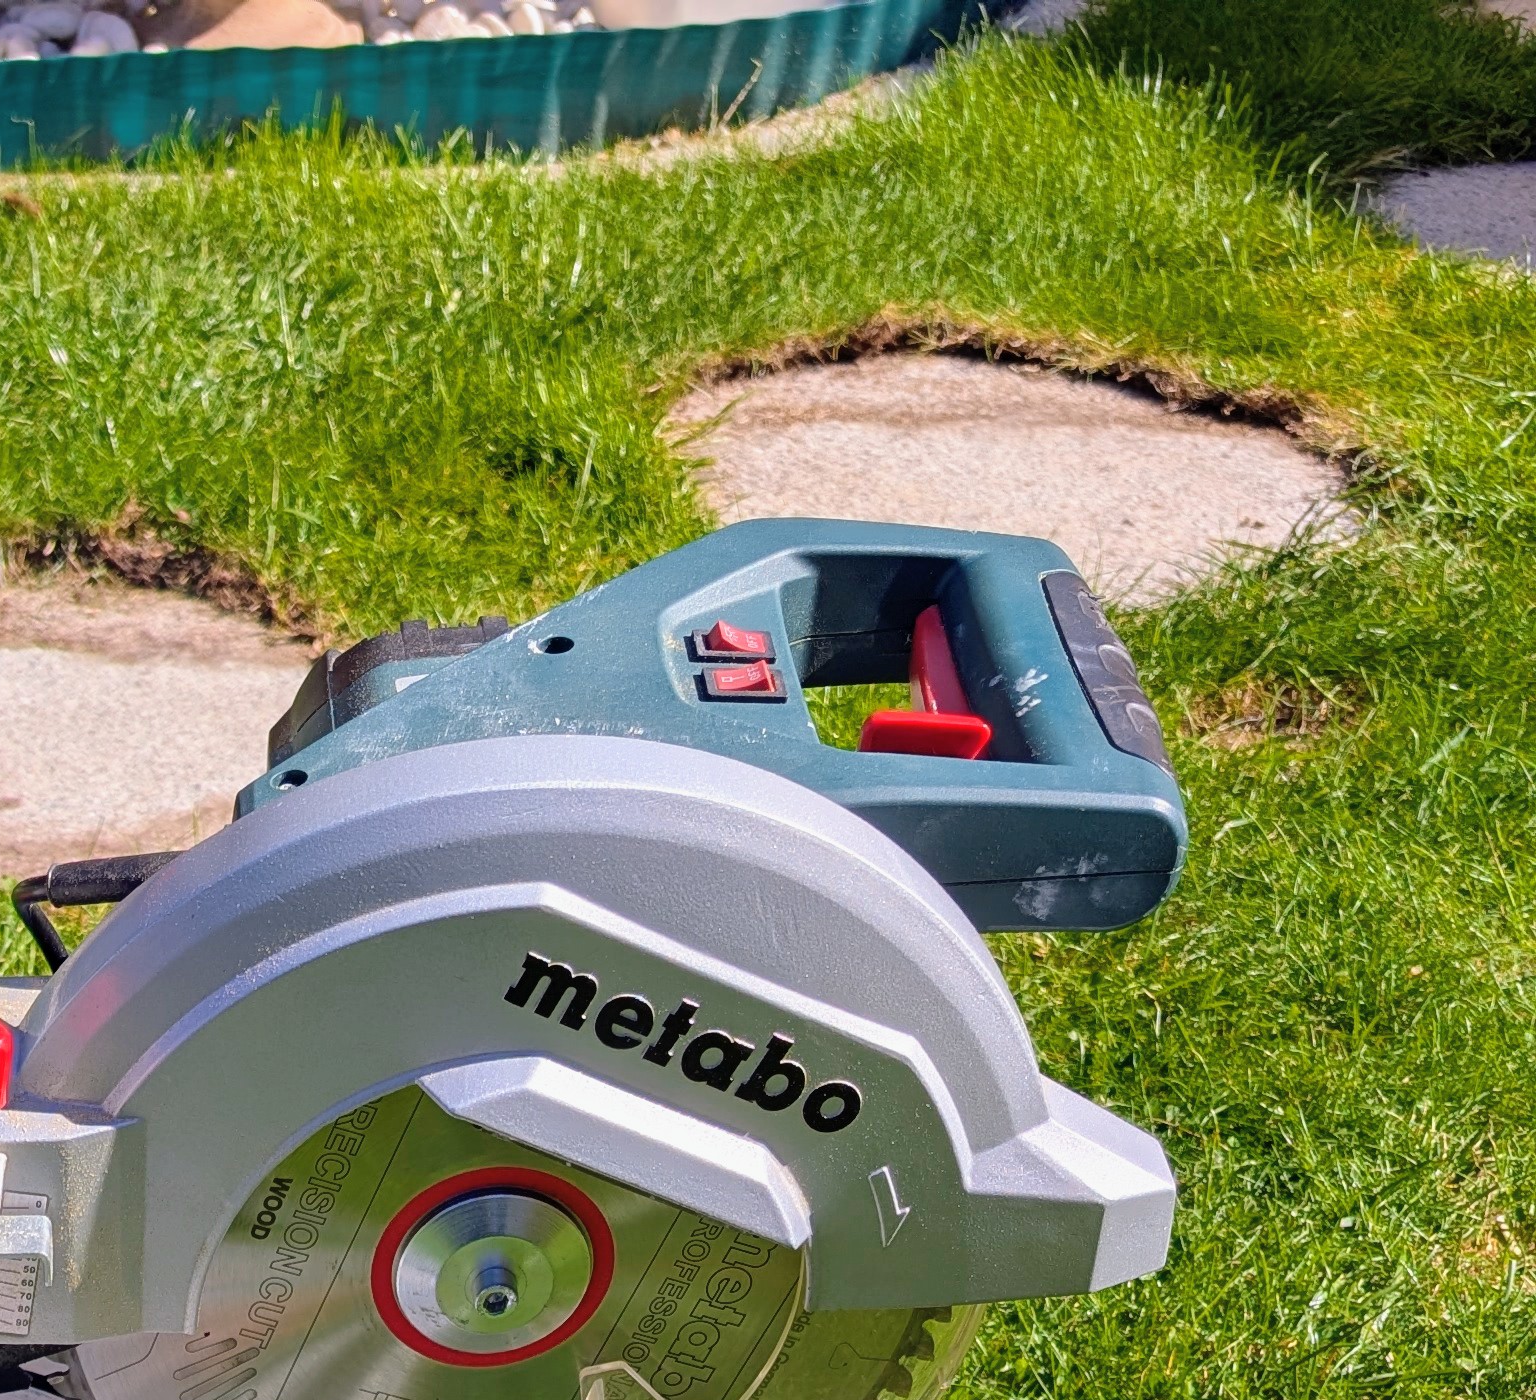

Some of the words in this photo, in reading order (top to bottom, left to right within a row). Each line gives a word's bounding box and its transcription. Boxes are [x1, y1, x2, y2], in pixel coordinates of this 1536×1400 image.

[504, 951, 863, 1134] metabo
[269, 1097, 383, 1277] RECISION
[251, 1177, 293, 1240] WOOD
[22, 1265, 36, 1274] 50
[20, 1279, 34, 1287] 60
[19, 1292, 32, 1300] 70
[17, 1305, 30, 1313] 80
[239, 1276, 294, 1350] CUT
[15, 1318, 29, 1327] 90
